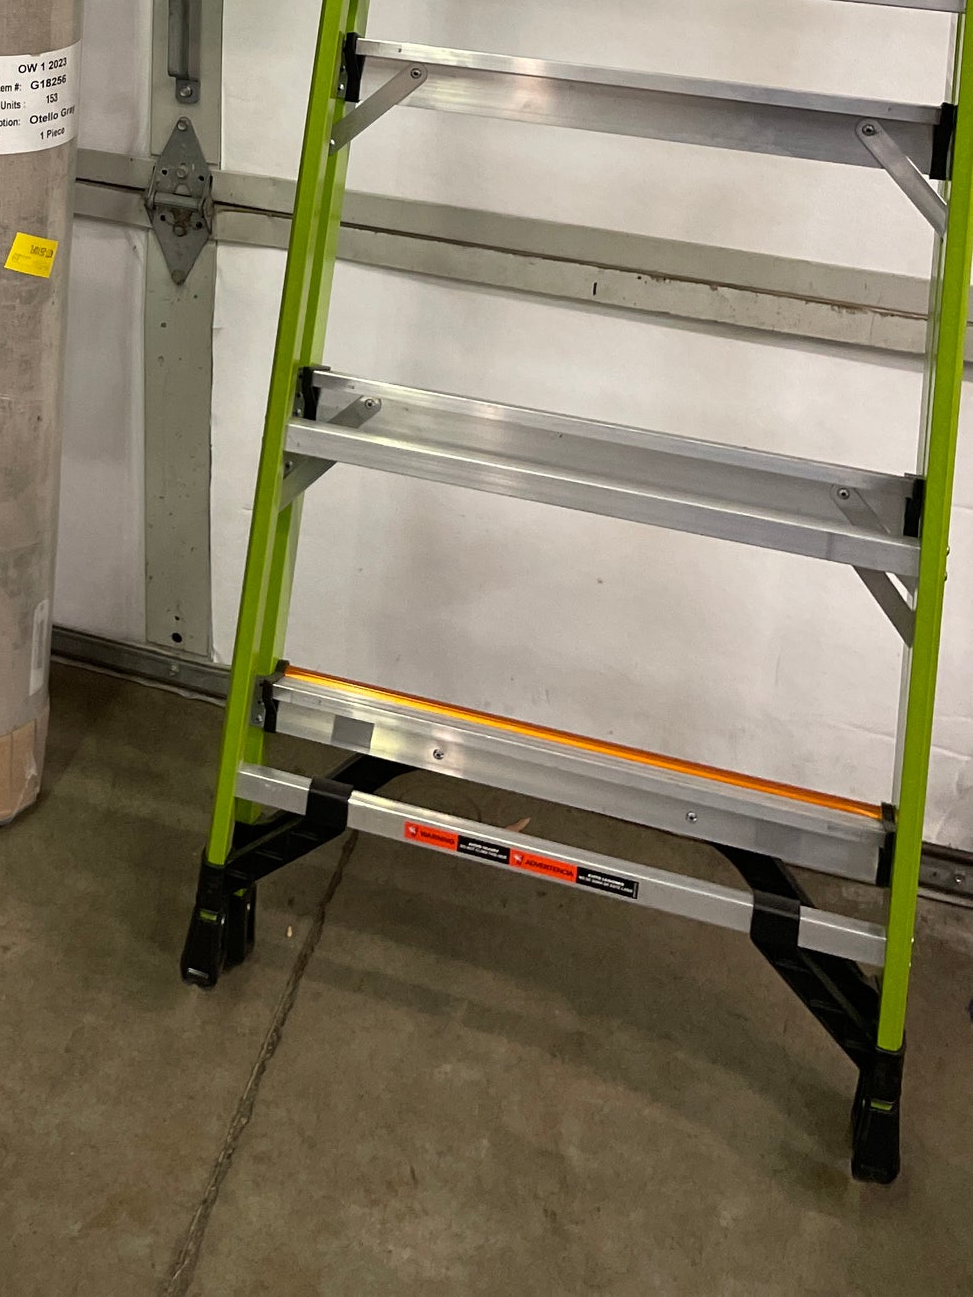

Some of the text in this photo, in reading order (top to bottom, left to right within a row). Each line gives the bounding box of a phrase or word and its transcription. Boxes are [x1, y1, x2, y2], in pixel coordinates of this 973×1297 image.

[18, 63, 38, 74] OW
[40, 62, 45, 71] 1
[48, 57, 67, 70] 2023
[30, 74, 67, 90] G18256
[0, 100, 21, 110] Units
[46, 93, 58, 104] 153
[29, 112, 59, 125] Otello
[40, 131, 44, 140] 1
[46, 127, 66, 139] Piece
[420, 830, 455, 844] WARNING
[525, 860, 574, 876] ADVERTENCIA
